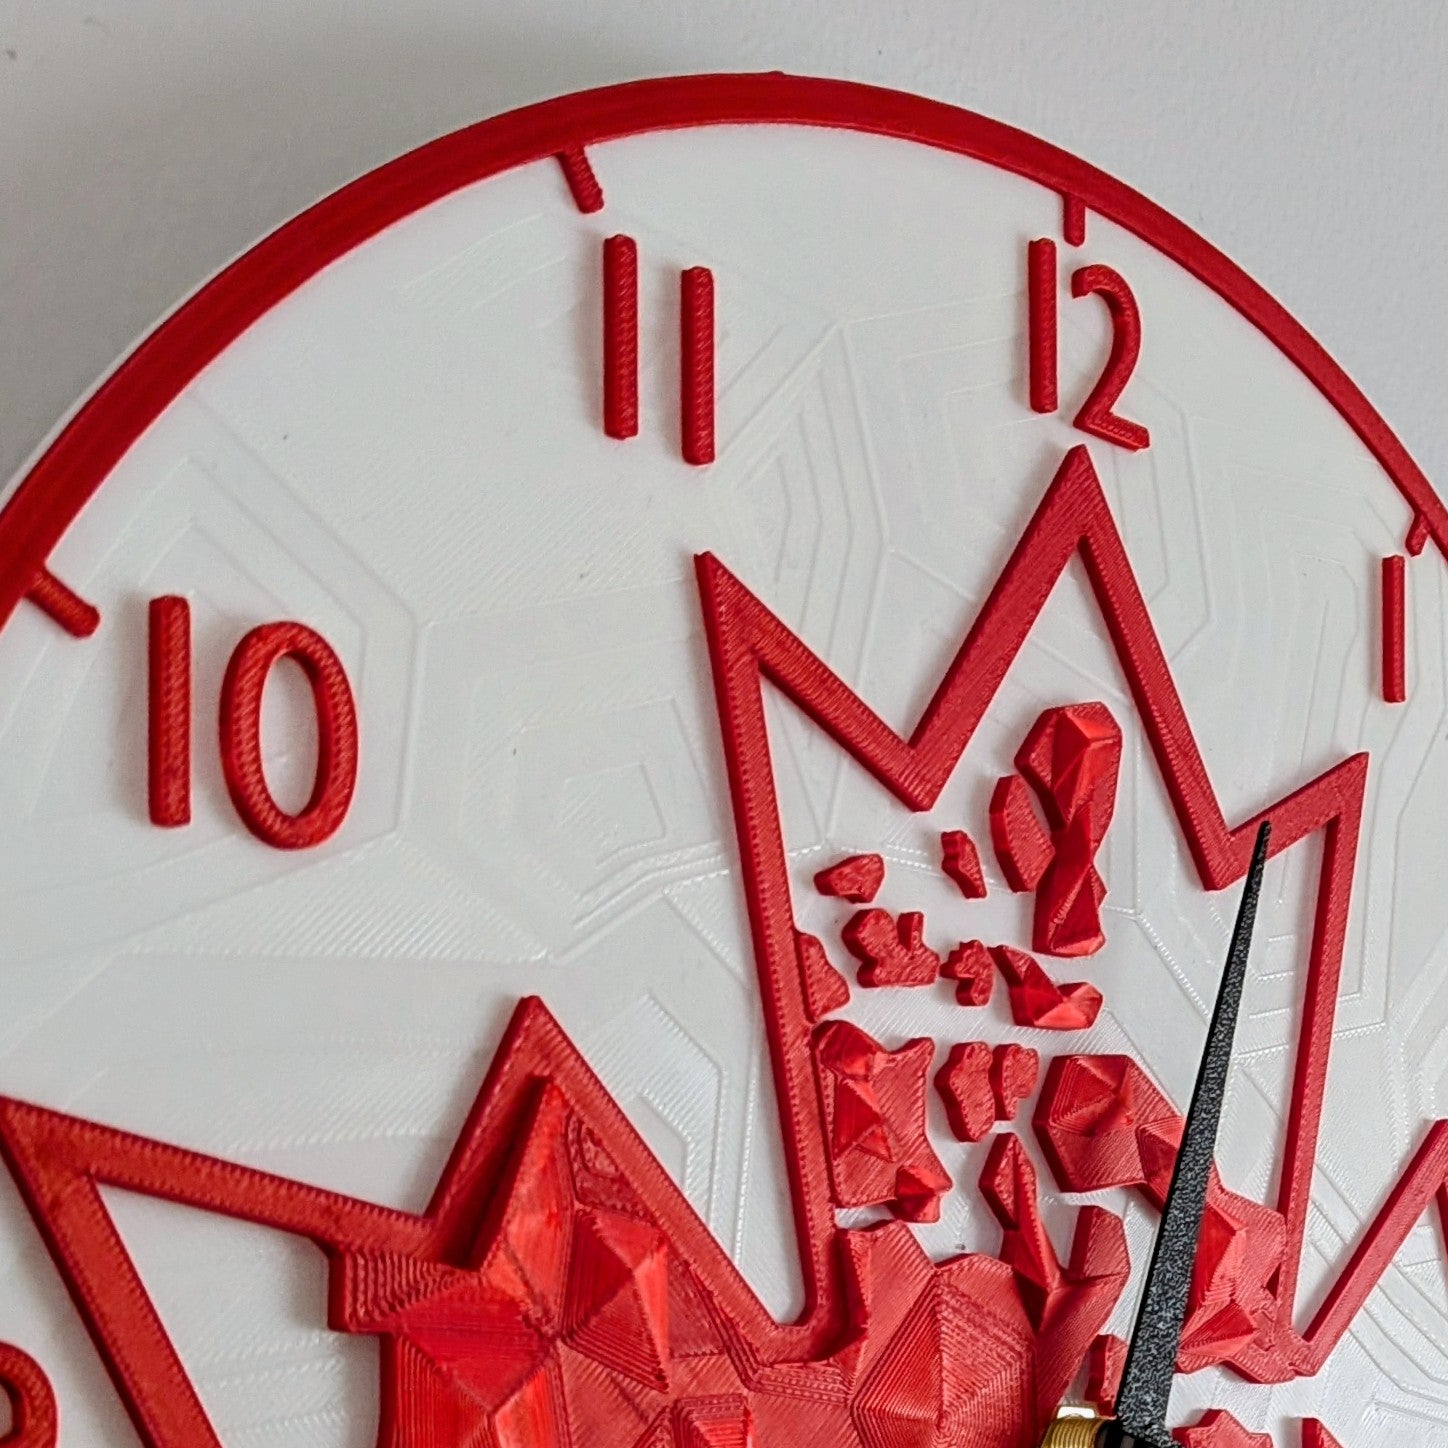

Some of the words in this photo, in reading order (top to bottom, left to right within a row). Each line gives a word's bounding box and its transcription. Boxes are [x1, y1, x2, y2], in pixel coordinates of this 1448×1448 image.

[602, 235, 716, 467] 11
[1026, 237, 1152, 453] 12
[147, 596, 359, 851] 10
[1381, 555, 1406, 704] 1
